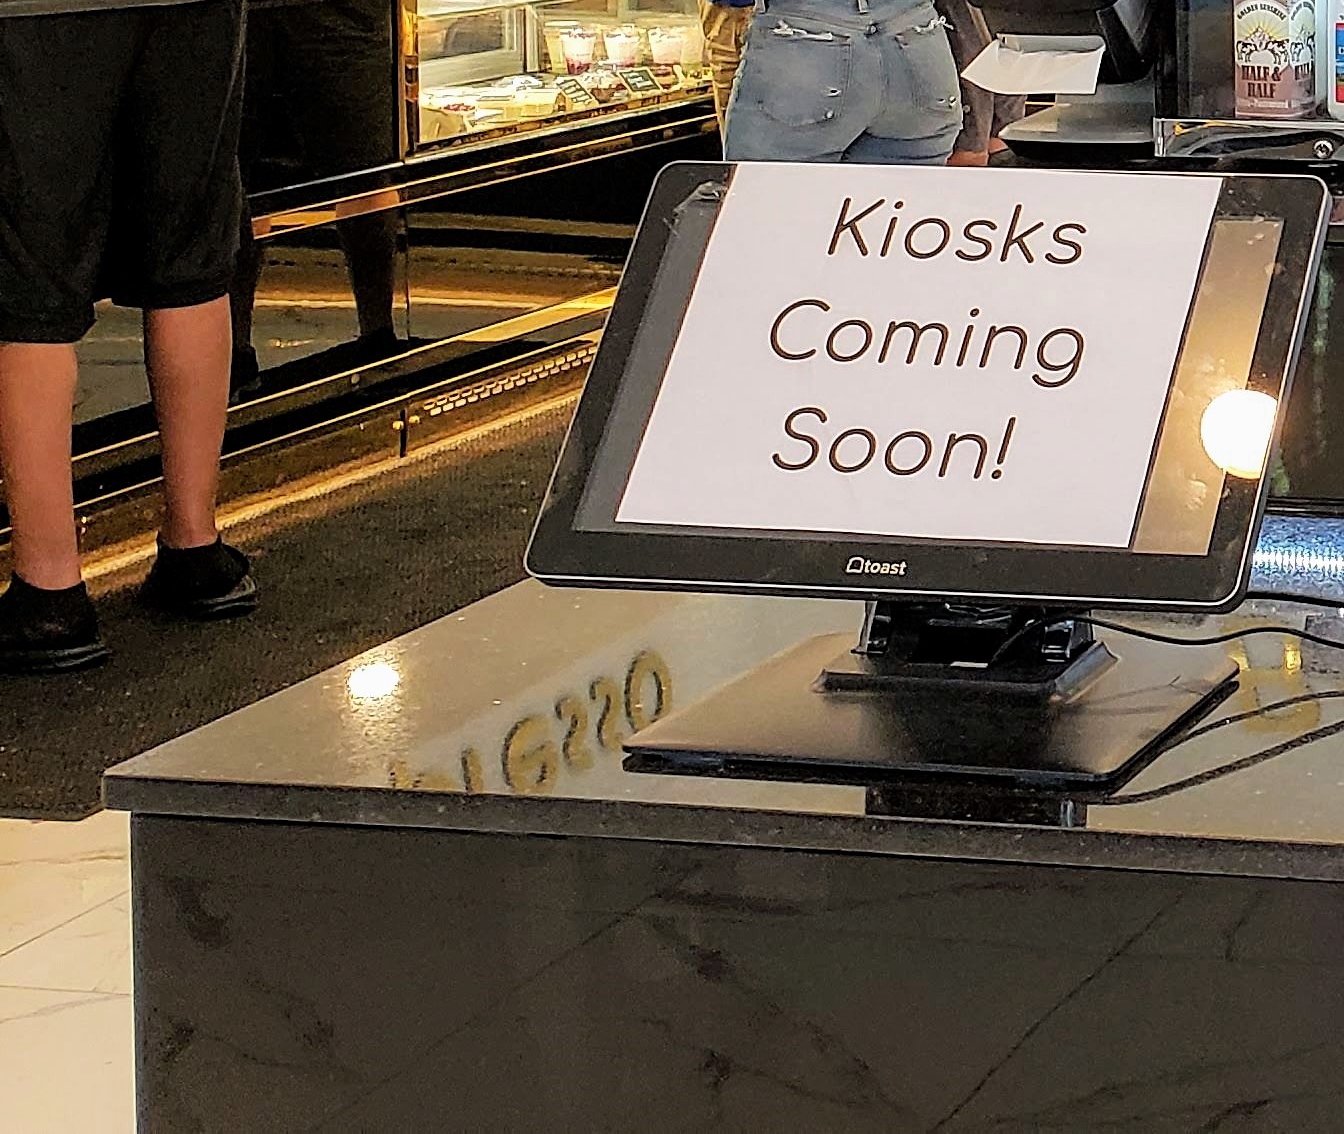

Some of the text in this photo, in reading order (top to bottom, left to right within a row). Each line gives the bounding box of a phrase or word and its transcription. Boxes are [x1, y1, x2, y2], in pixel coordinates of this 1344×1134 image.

[1241, 65, 1282, 82] HALF &
[1247, 82, 1277, 99] HALF
[827, 197, 1087, 265] Kiosks
[769, 298, 1085, 388] Coming
[771, 407, 1016, 480] Soon!
[864, 559, 907, 576] toast
